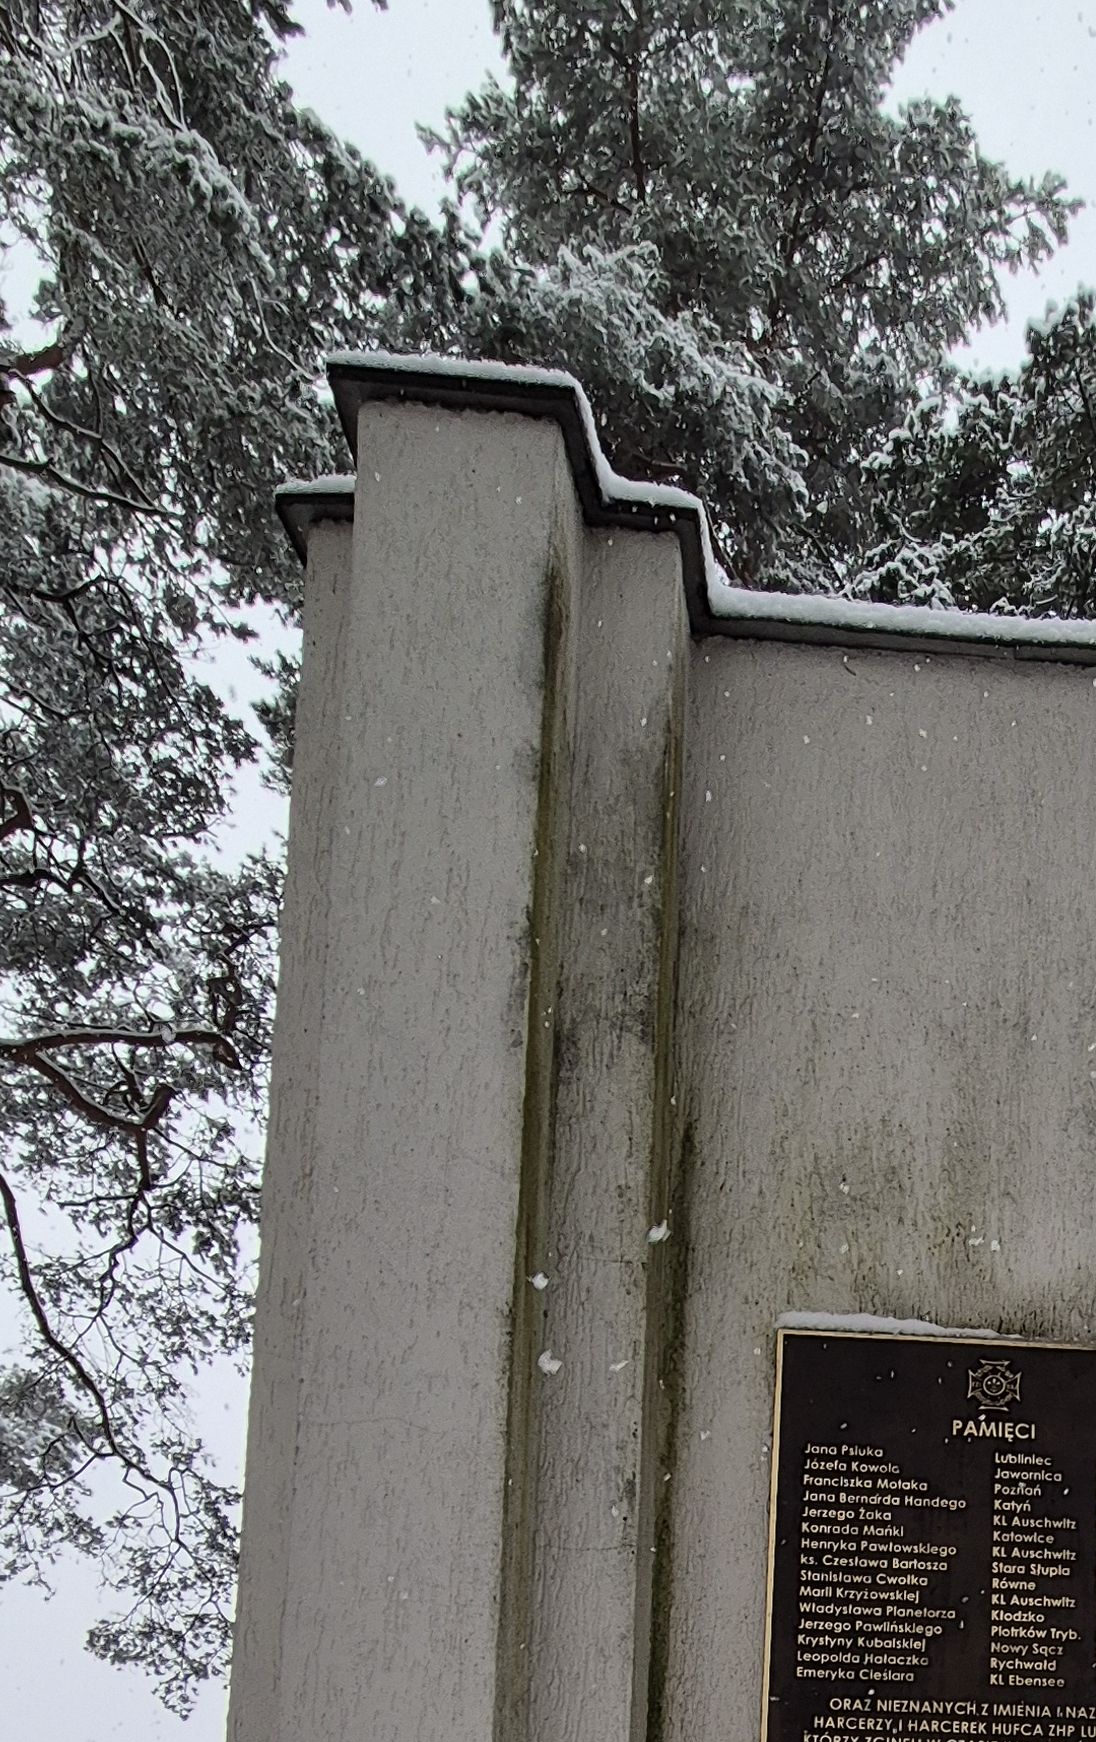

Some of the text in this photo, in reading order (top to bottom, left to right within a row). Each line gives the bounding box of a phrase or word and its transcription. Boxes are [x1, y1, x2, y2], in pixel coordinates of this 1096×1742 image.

[952, 1419, 1036, 1442] PAMIĘCI
[804, 1443, 838, 1455] Jana
[841, 1444, 884, 1458] Psiuka
[994, 1452, 1052, 1466] Lubliniec
[804, 1458, 847, 1471] Józefa
[851, 1461, 900, 1474] Kowola
[994, 1468, 1062, 1482] Jawornica
[803, 1475, 873, 1488] Franciszka
[994, 1483, 1041, 1496] Poznań
[803, 1490, 836, 1502] Jana
[839, 1492, 900, 1506] Bernarda
[904, 1495, 967, 1510] Handego
[994, 1499, 1032, 1514] Katyń
[802, 1507, 855, 1521] Jerzego
[858, 1507, 892, 1521] Żaka
[993, 1515, 1007, 1526] KL
[1011, 1517, 1077, 1530] Auschwitz
[801, 1522, 859, 1535] Konrada
[863, 1525, 904, 1537] Mańki
[993, 1531, 1055, 1544] Katowice
[801, 1538, 857, 1552] Henryka
[861, 1540, 957, 1557] Pawłowskiego
[992, 1546, 1007, 1558] KL
[1011, 1548, 1077, 1561] Auschwitz
[800, 1554, 818, 1565] ks.
[822, 1555, 888, 1569] Czesława
[892, 1558, 948, 1571] Bartosza
[991, 1562, 1025, 1574] Stara
[1030, 1563, 1071, 1578] Słupia
[800, 1570, 872, 1584] Stanisława
[992, 1577, 1036, 1591] Równe
[799, 1586, 832, 1598] Marii
[836, 1587, 920, 1604] Krzyżowskiej
[991, 1594, 1006, 1605] KL
[1010, 1595, 1076, 1608] Auschwitz
[799, 1602, 882, 1616] Władysława
[991, 1610, 1045, 1623] Kłodzko
[798, 1618, 852, 1633] Jerzego
[855, 1620, 943, 1637] Pawlińskiego
[990, 1625, 1047, 1639] Piotrków
[1050, 1628, 1081, 1642] Tryb.
[797, 1634, 853, 1648] Krystyny
[857, 1637, 926, 1652] Kubalskiej
[990, 1642, 1028, 1656] Nowy
[1032, 1643, 1064, 1657] Sącz
[797, 1650, 860, 1664] Leopolda
[796, 1667, 855, 1681] Emeryka
[859, 1669, 915, 1682] Cieślara
[990, 1674, 1005, 1686] KL
[1009, 1675, 1065, 1687] Ebensee
[829, 1698, 872, 1712] ORAZ
[876, 1700, 976, 1715] NIEZNANYCH
[980, 1703, 989, 1716] Z
[993, 1704, 1052, 1717] IMIENIA
[1056, 1706, 1061, 1717] I
[813, 1716, 893, 1731] HARCERZY
[898, 1719, 903, 1731] I
[908, 1720, 987, 1734] HARCEREK
[991, 1723, 1044, 1736] HUFCA
[1048, 1724, 1075, 1737] ZHP
